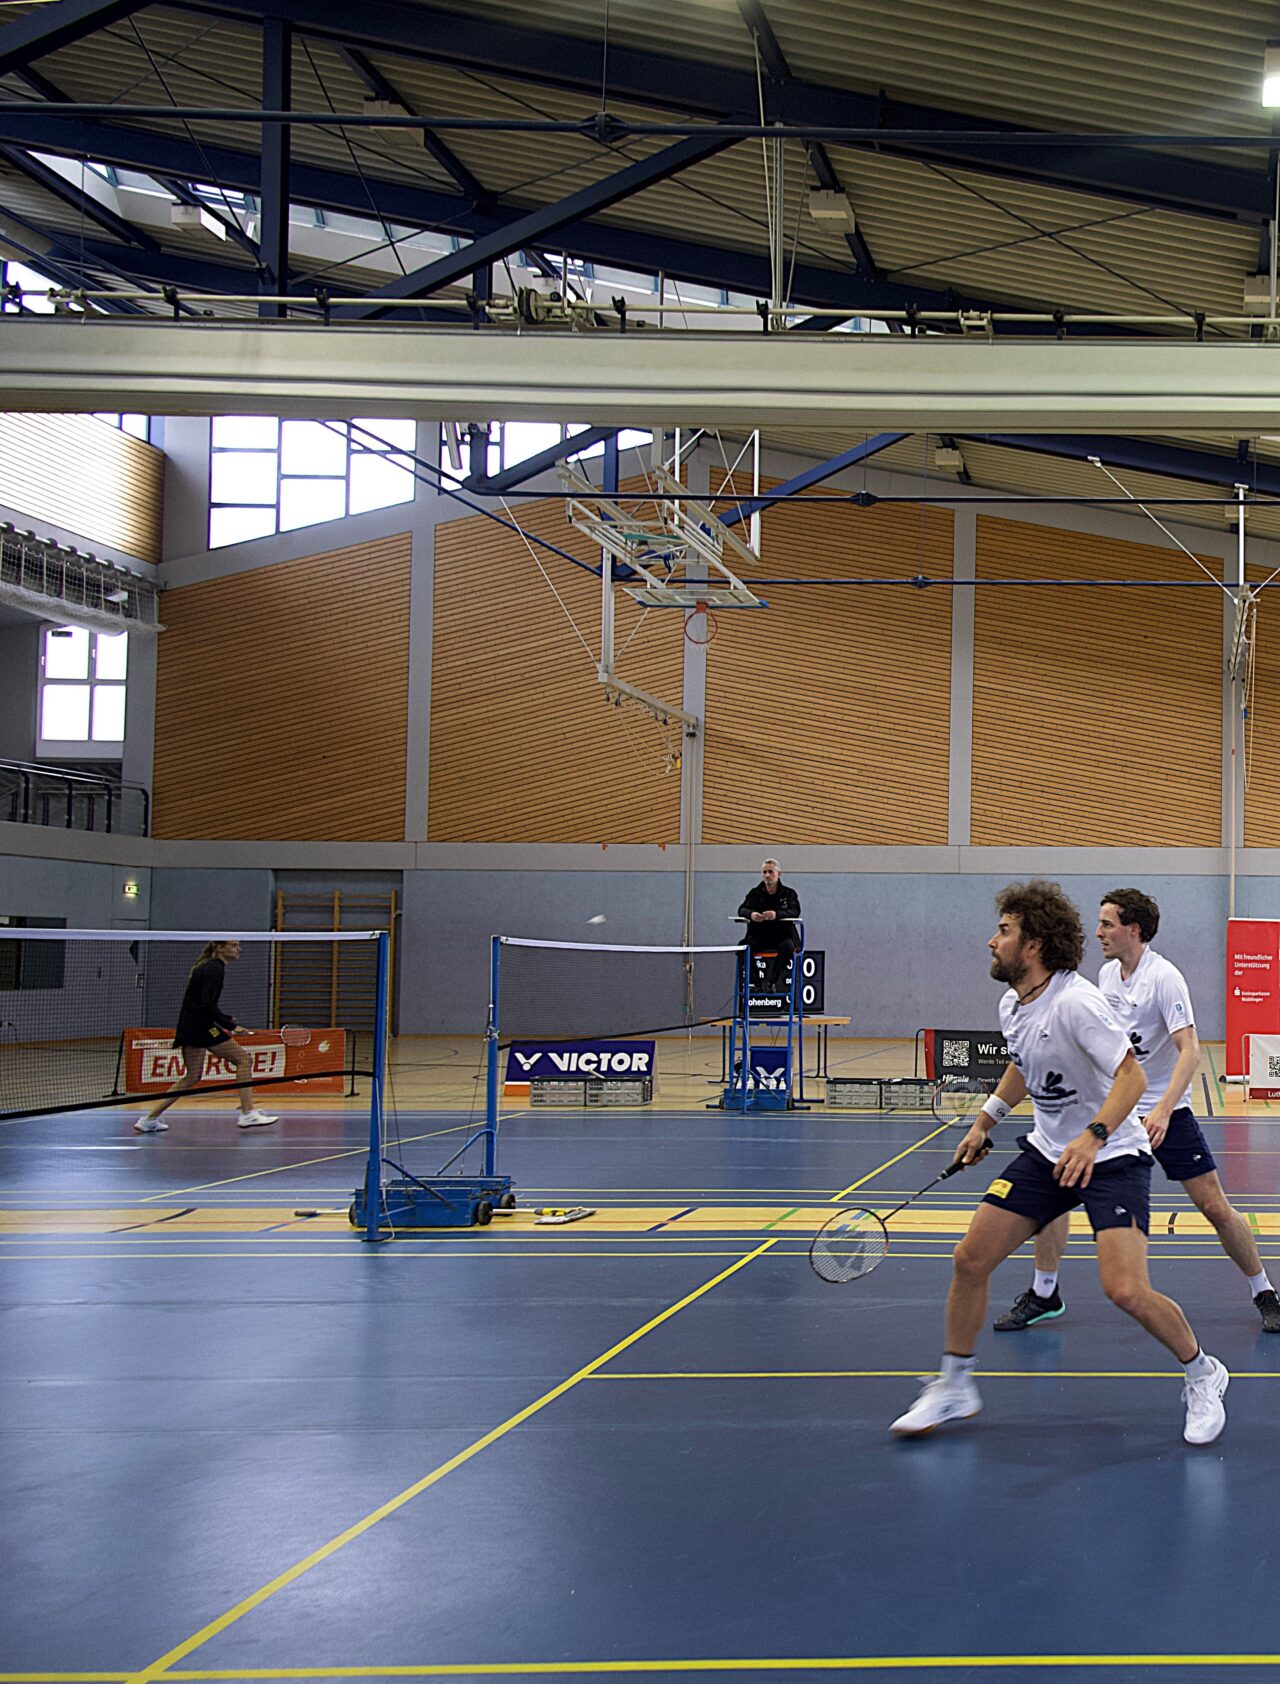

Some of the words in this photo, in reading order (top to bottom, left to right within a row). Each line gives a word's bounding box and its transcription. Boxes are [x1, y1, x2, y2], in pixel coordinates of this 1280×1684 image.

[803, 958, 815, 977] 0
[803, 985, 815, 1004] 0
[977, 1043, 998, 1054] Wir
[548, 1052, 650, 1072] VICTOR
